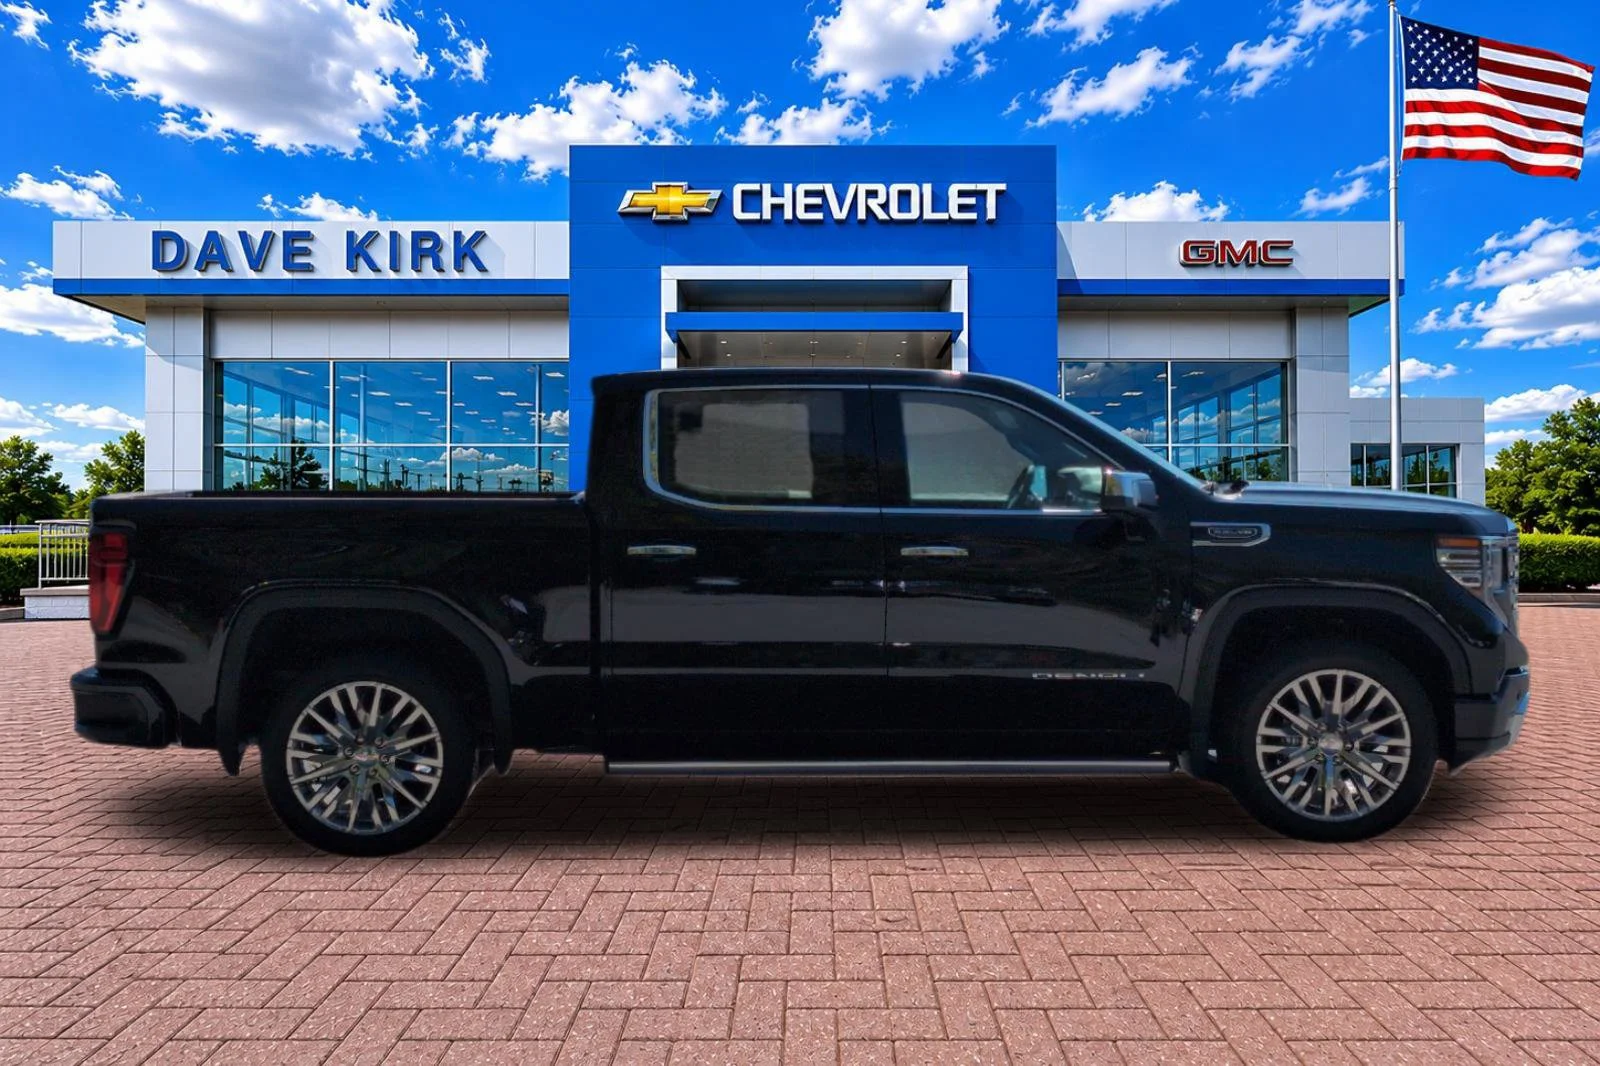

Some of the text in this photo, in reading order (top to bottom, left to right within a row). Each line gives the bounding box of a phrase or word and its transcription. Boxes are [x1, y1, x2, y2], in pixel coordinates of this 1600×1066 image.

[733, 183, 1007, 222] CHEVROLET
[151, 230, 489, 273] DAVE KIRK
[1179, 239, 1295, 267] GMC
